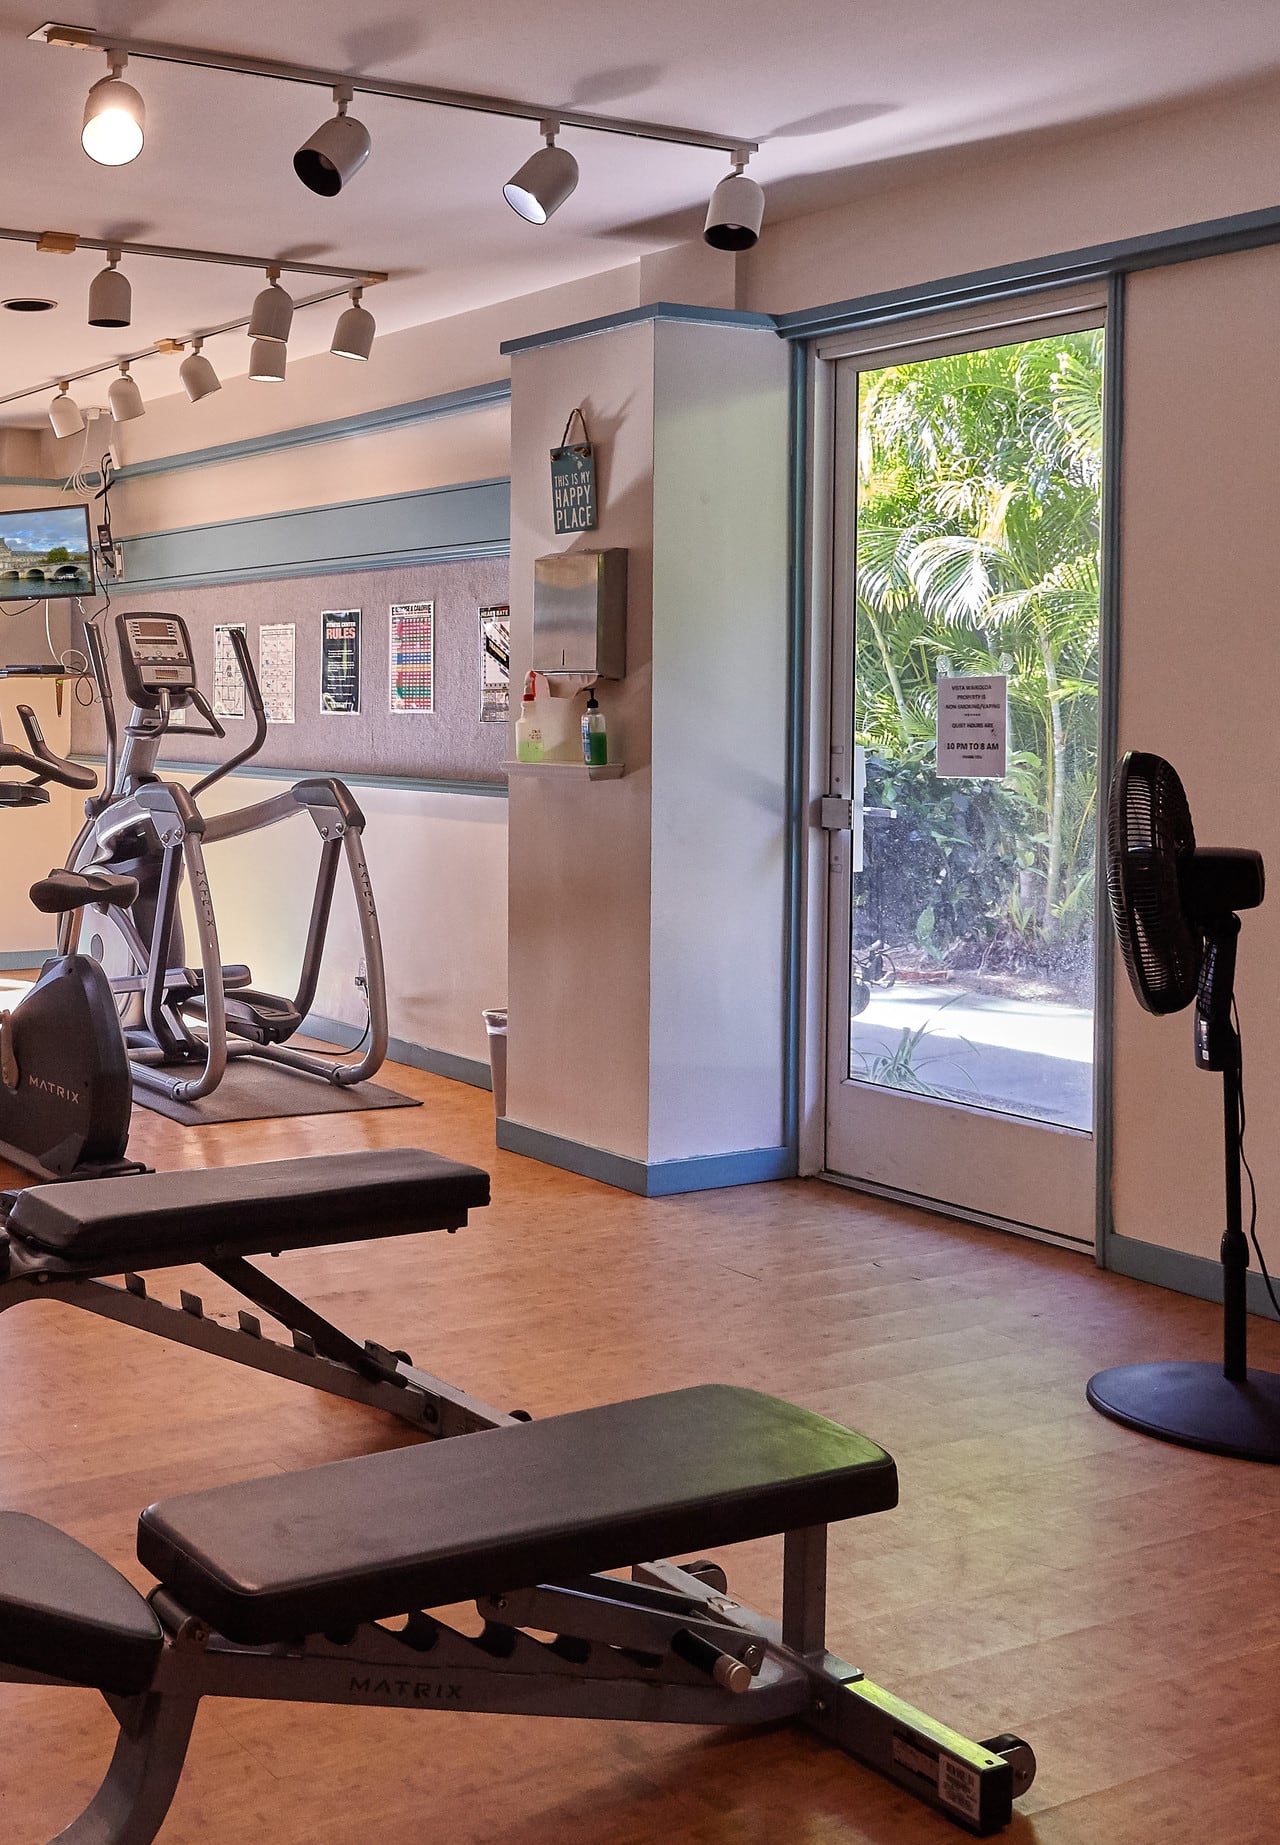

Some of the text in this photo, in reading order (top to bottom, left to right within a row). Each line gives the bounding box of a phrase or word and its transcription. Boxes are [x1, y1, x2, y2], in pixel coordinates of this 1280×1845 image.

[554, 471, 590, 488] THIS IS MY
[555, 485, 590, 508] HAPPY
[556, 506, 592, 530] PLACE
[326, 627, 356, 640] RULES
[946, 742, 999, 750] 10 PM TO 8 AM
[196, 870, 215, 926] MATRIX
[358, 862, 376, 917] MATRIX
[29, 1074, 79, 1104] MATRIX
[349, 1677, 464, 1699] MATRIX
